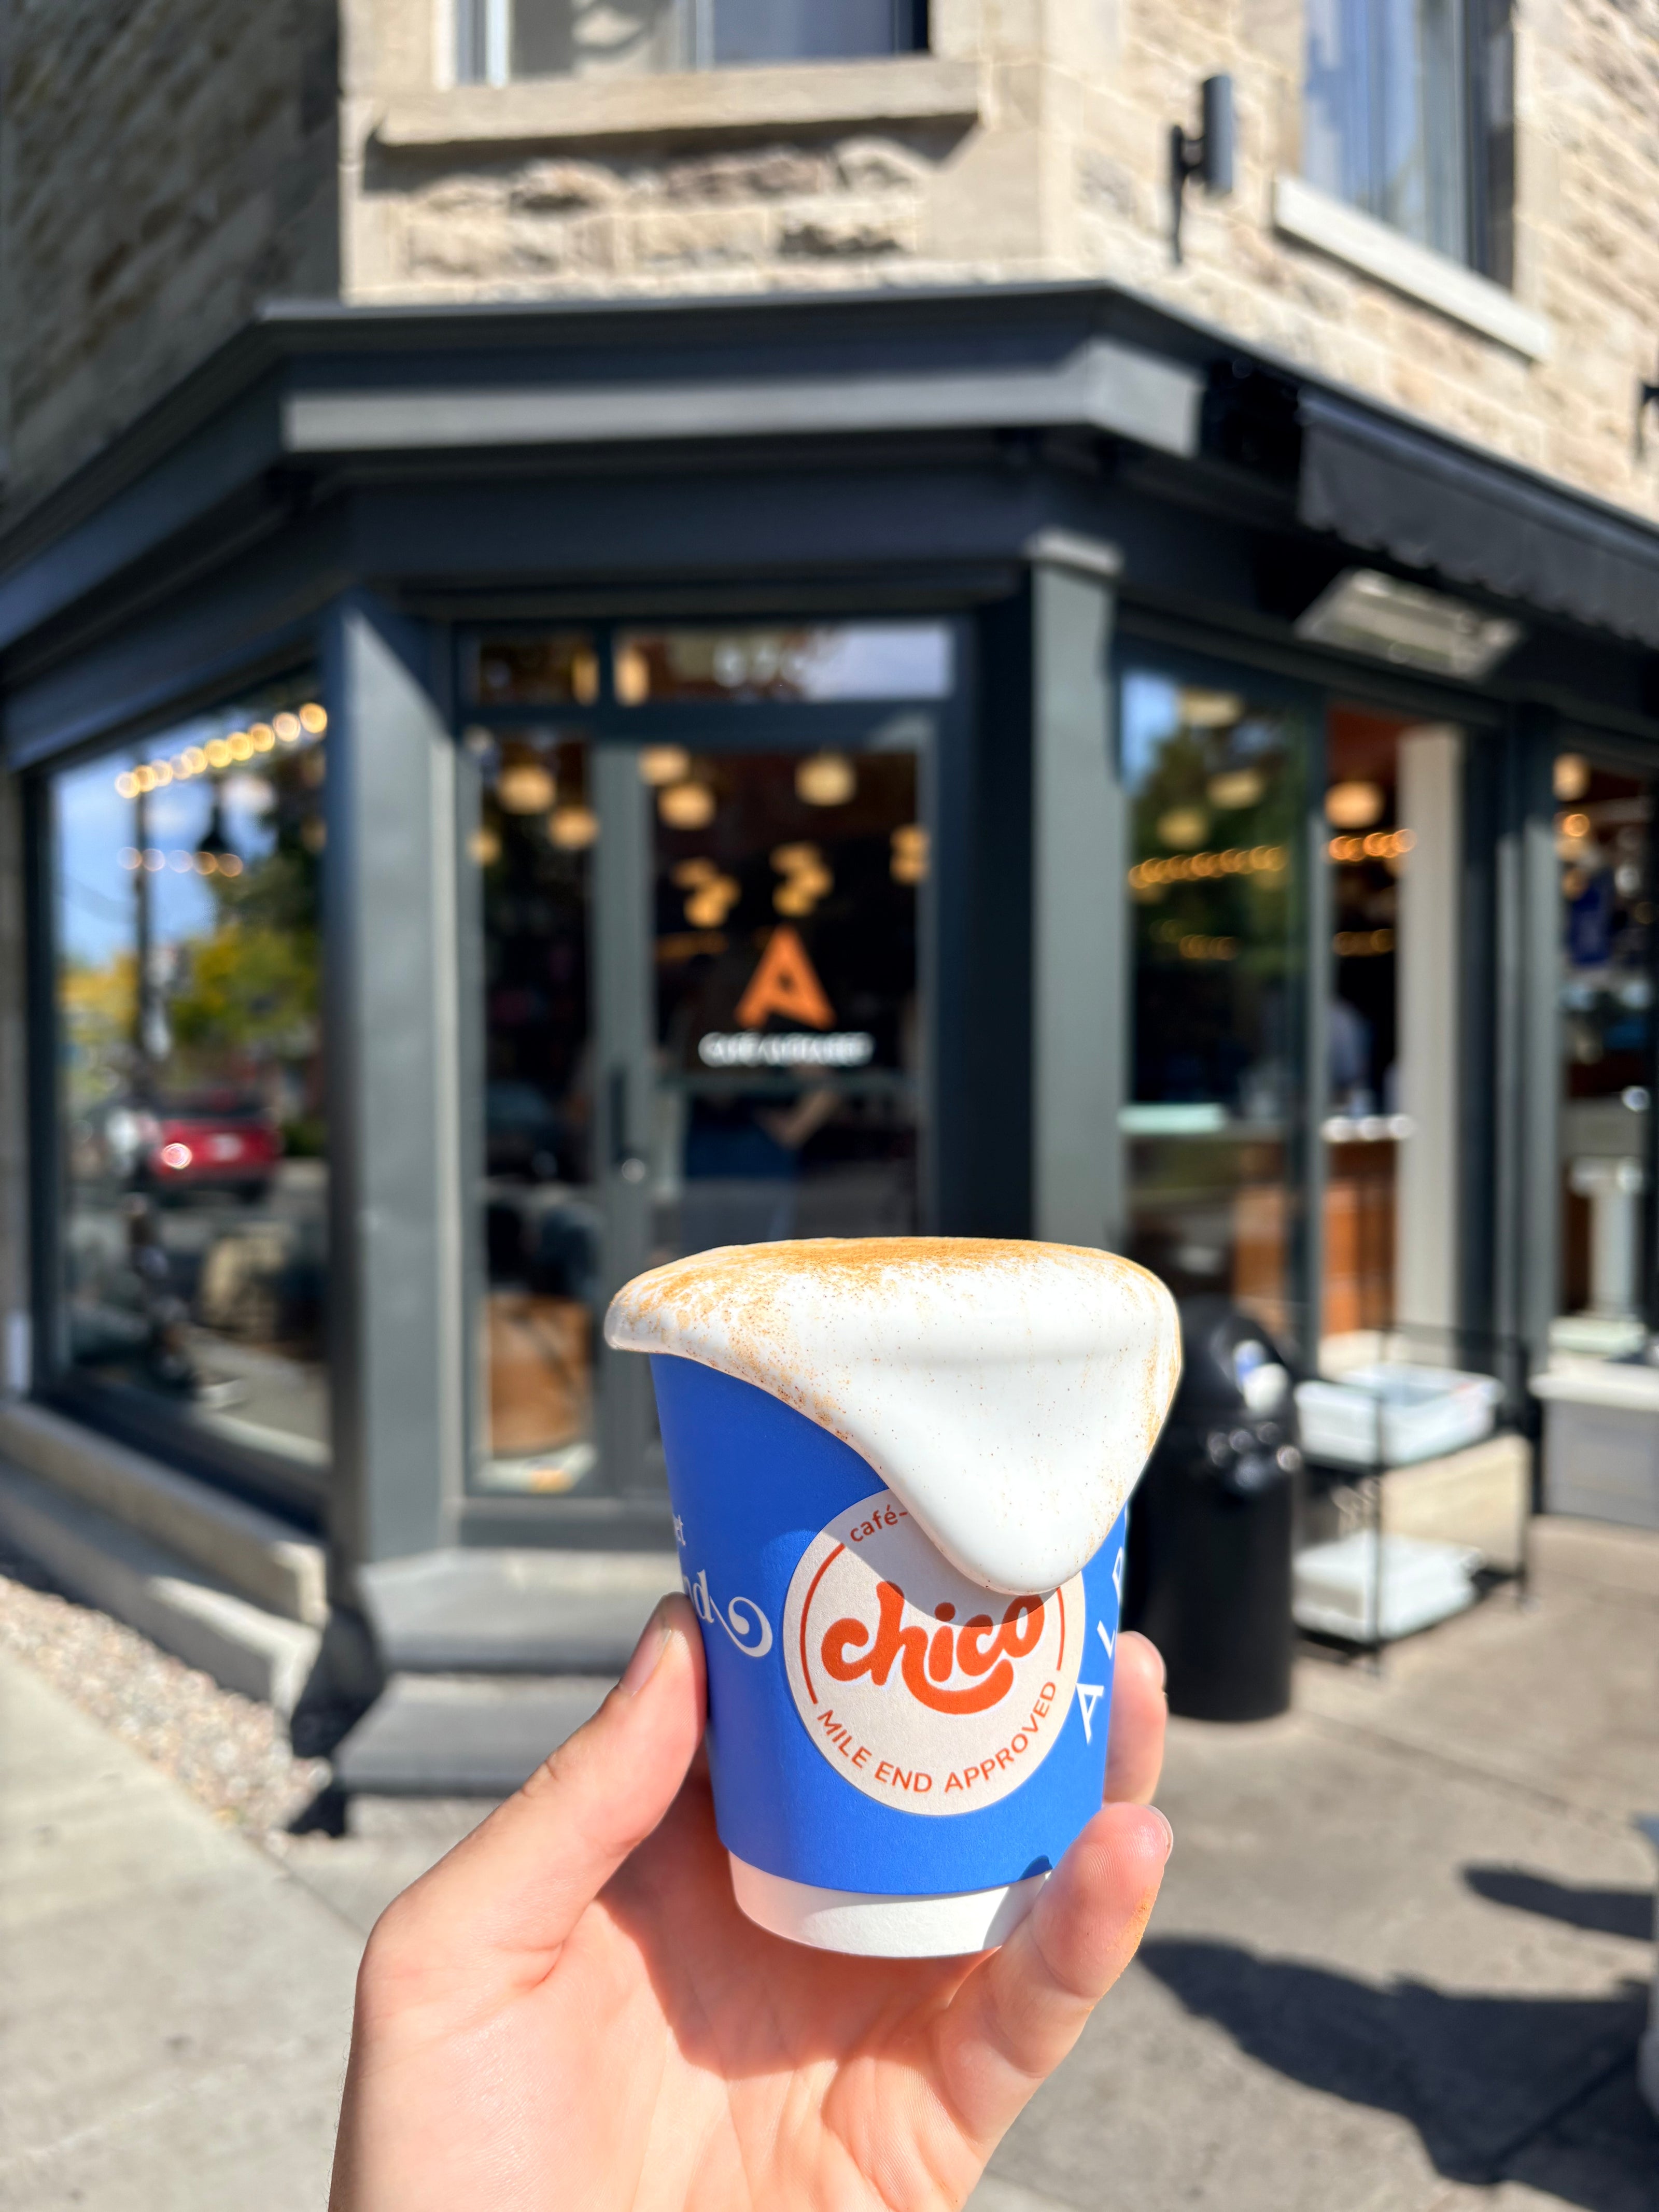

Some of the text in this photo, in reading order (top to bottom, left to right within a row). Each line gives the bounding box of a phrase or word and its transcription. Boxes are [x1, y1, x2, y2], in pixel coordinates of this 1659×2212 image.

[735, 925, 836, 1029] A
[821, 1581, 1045, 1715] chico
[817, 1681, 1056, 1793] MILE END APPROVED
